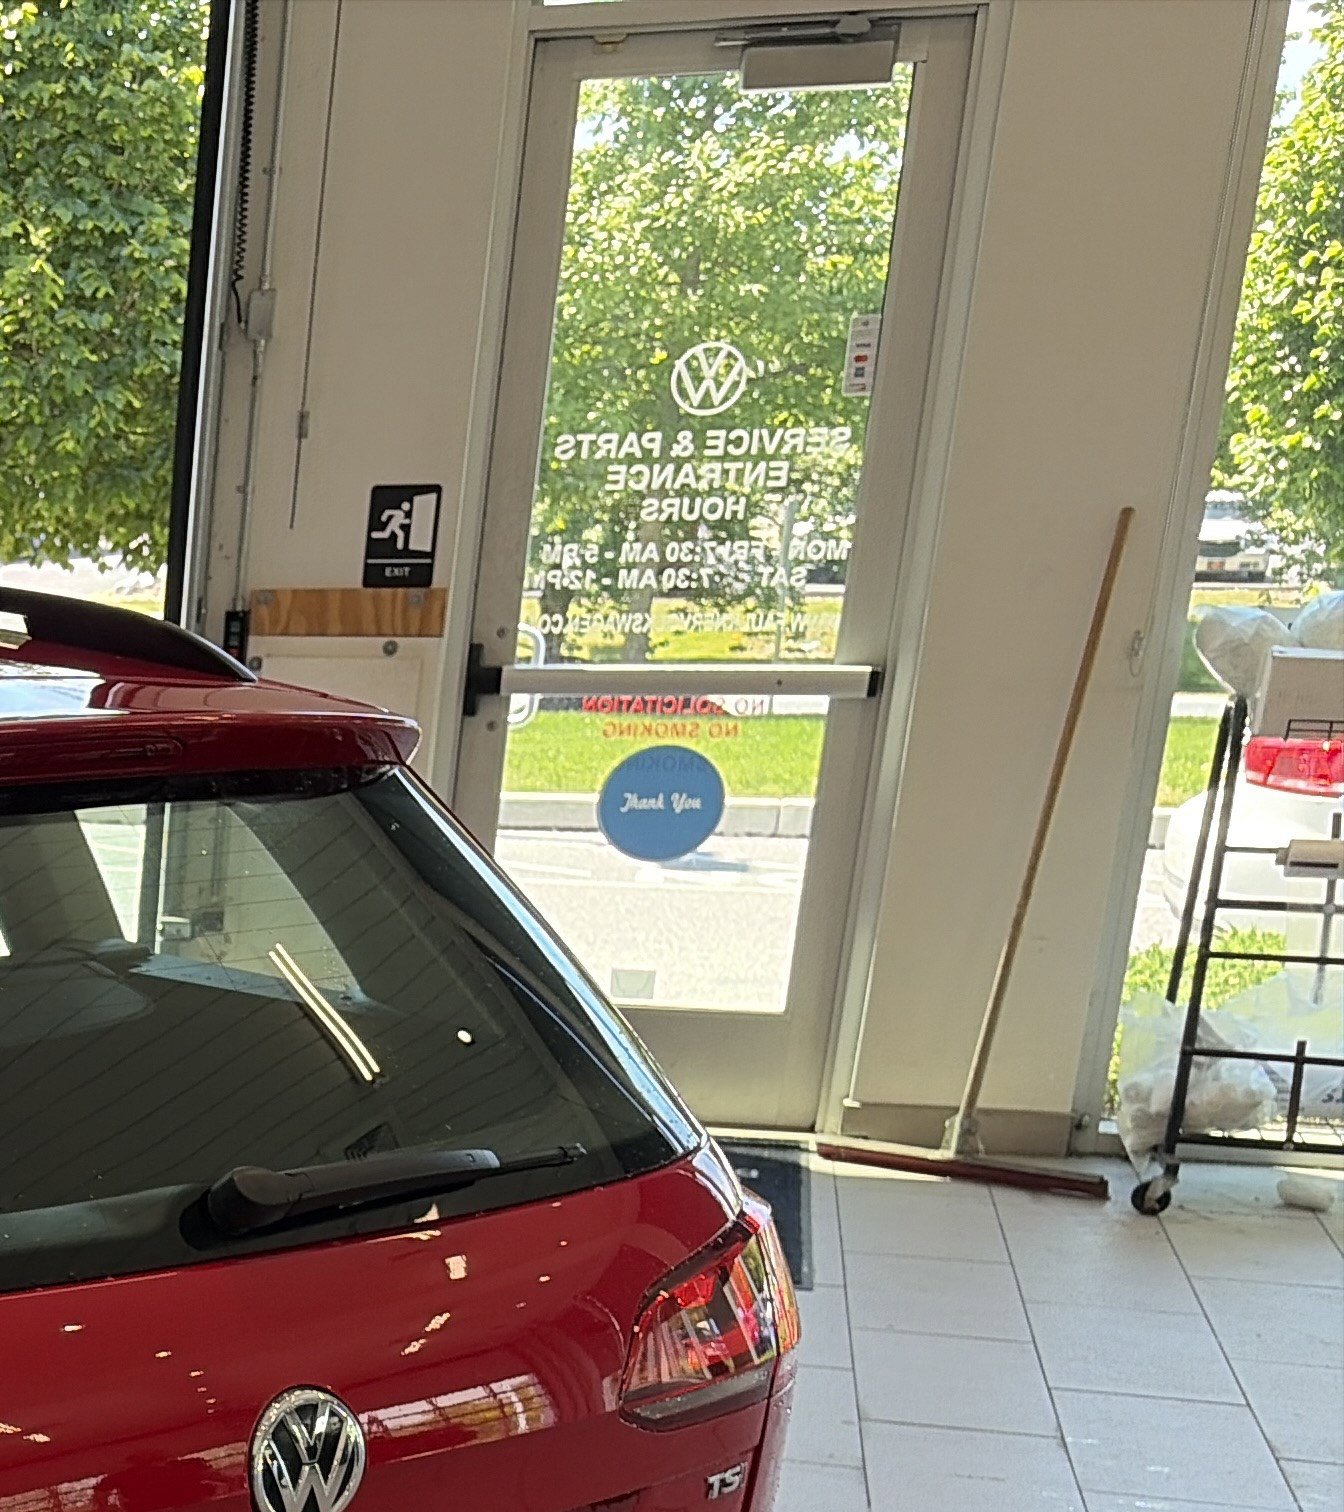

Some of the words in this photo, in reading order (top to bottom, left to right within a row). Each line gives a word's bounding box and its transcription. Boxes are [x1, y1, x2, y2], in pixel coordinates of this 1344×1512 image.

[384, 566, 411, 578] EXIT
[619, 792, 665, 813] Thank
[670, 792, 702, 814] You
